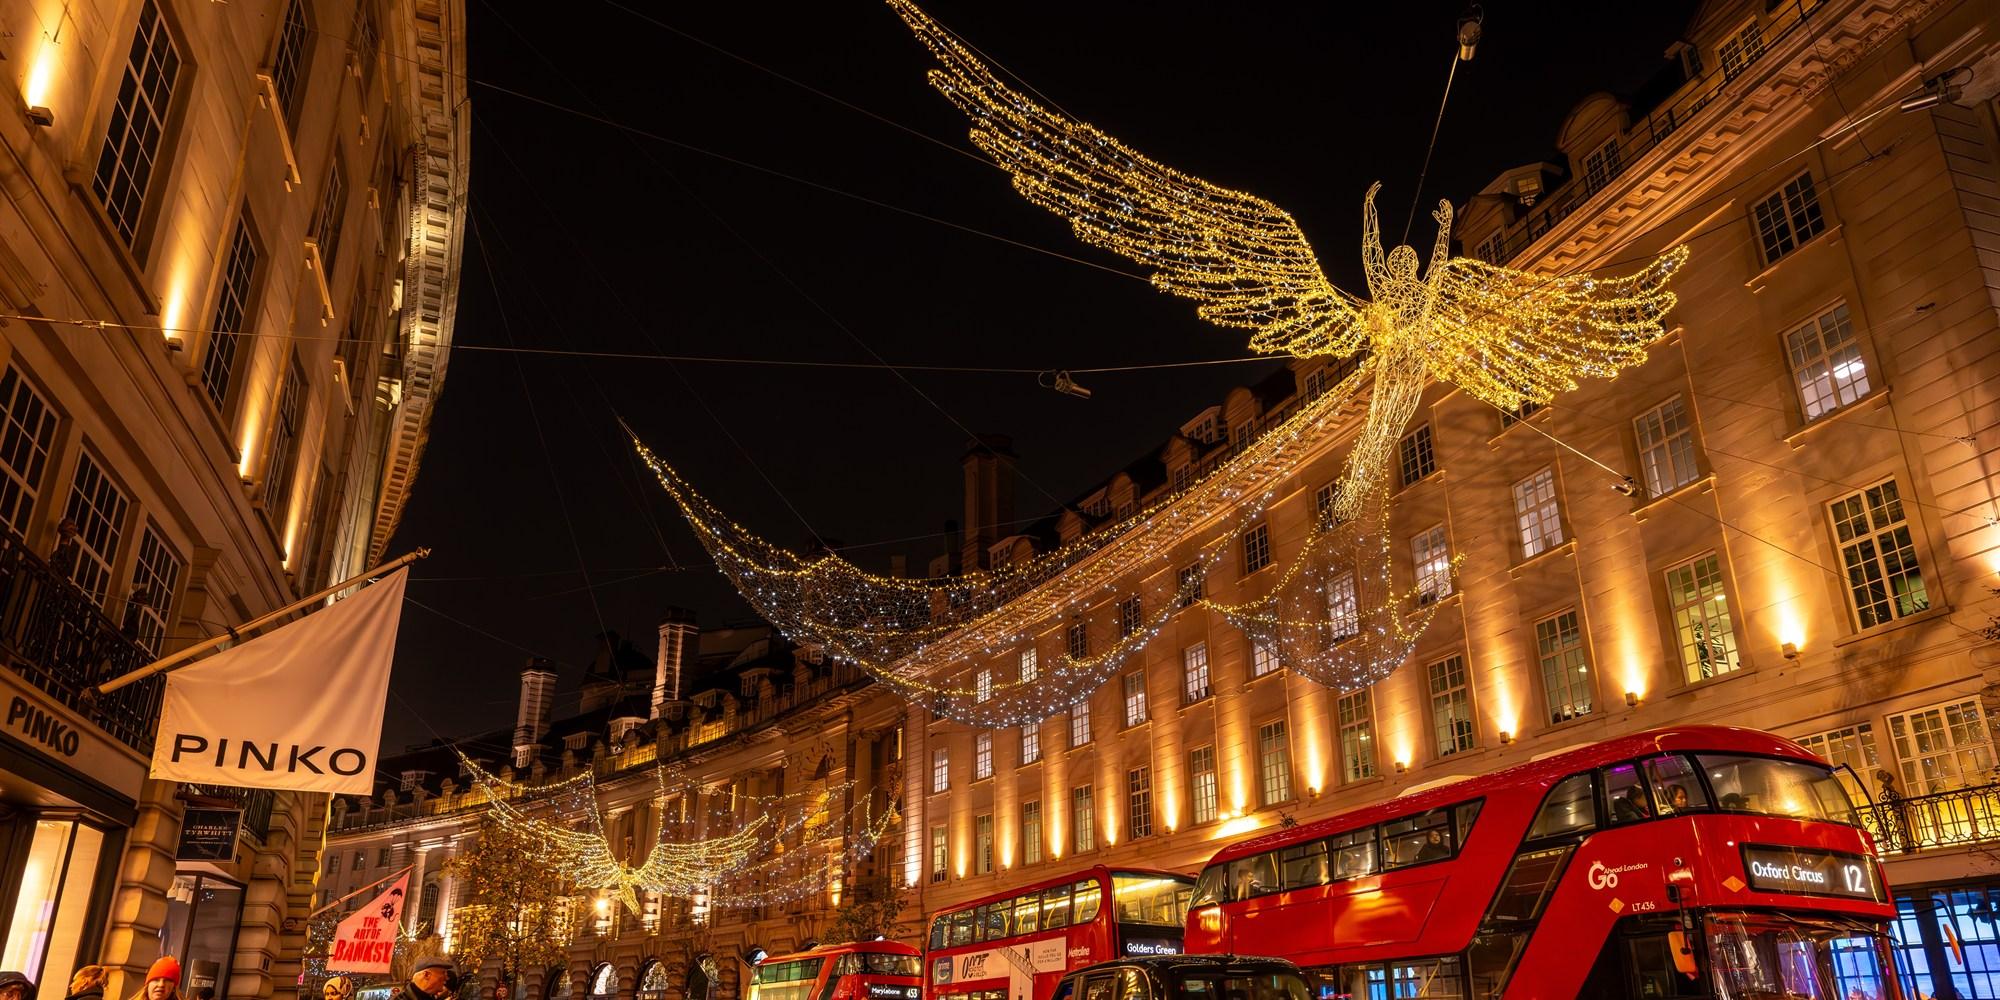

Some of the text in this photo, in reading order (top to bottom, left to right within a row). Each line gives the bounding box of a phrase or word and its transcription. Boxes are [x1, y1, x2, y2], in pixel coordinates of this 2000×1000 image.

[7, 696, 79, 757] PINKO
[171, 734, 367, 776] PINKO
[1588, 861, 1618, 890] Go
[1604, 862, 1648, 875] Ahead London
[1752, 861, 1824, 883] Oxford Circus
[1844, 864, 1866, 893] 12
[1632, 901, 1656, 912] LT436
[363, 917, 380, 928] THE
[354, 928, 382, 940] ART OF
[333, 939, 393, 964] BANKSY
[1068, 945, 1091, 959] Metroline
[1127, 942, 1177, 956] Golders Green
[906, 988, 918, 999] 453
